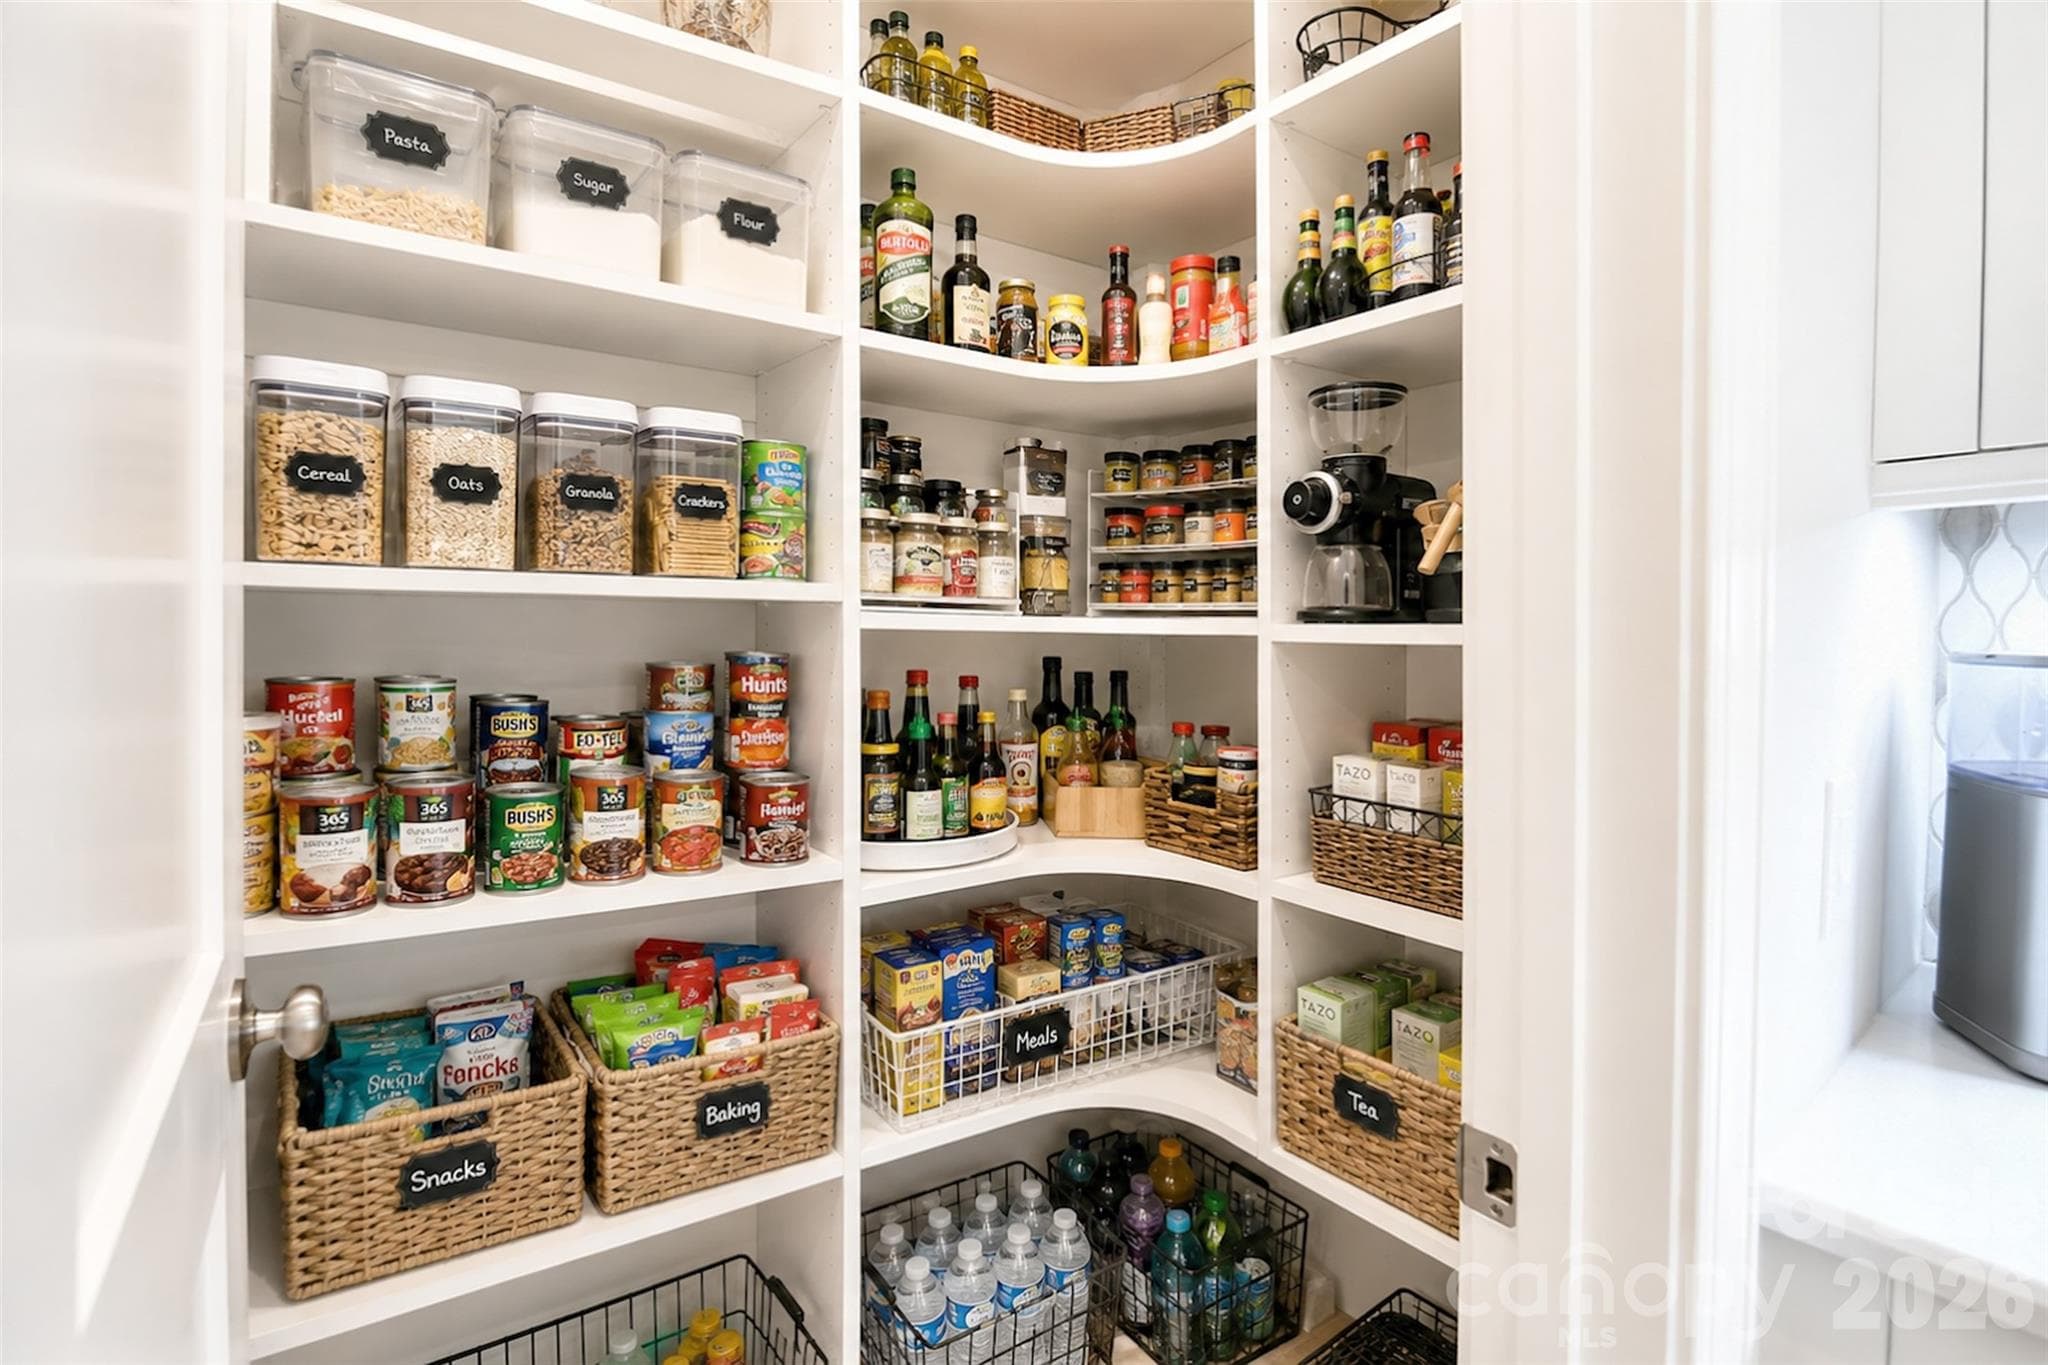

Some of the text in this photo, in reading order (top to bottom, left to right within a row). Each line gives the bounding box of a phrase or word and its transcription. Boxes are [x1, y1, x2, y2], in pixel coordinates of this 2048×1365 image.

[384, 128, 432, 156] Pasta
[573, 171, 614, 196] Sugar
[733, 212, 765, 231] Flour
[297, 465, 352, 483] Cereal
[448, 476, 485, 493] Oats
[565, 484, 614, 502] Granola
[677, 494, 725, 511] Crackers
[1336, 763, 1371, 780] TAZO
[420, 801, 449, 816] 365
[1301, 997, 1337, 1021] TAZO
[1016, 1024, 1060, 1054] Meals
[1396, 1019, 1435, 1044] TAZO
[705, 1101, 762, 1125] Baking
[1347, 1090, 1380, 1121] Tea
[410, 1159, 487, 1193] Snacks
